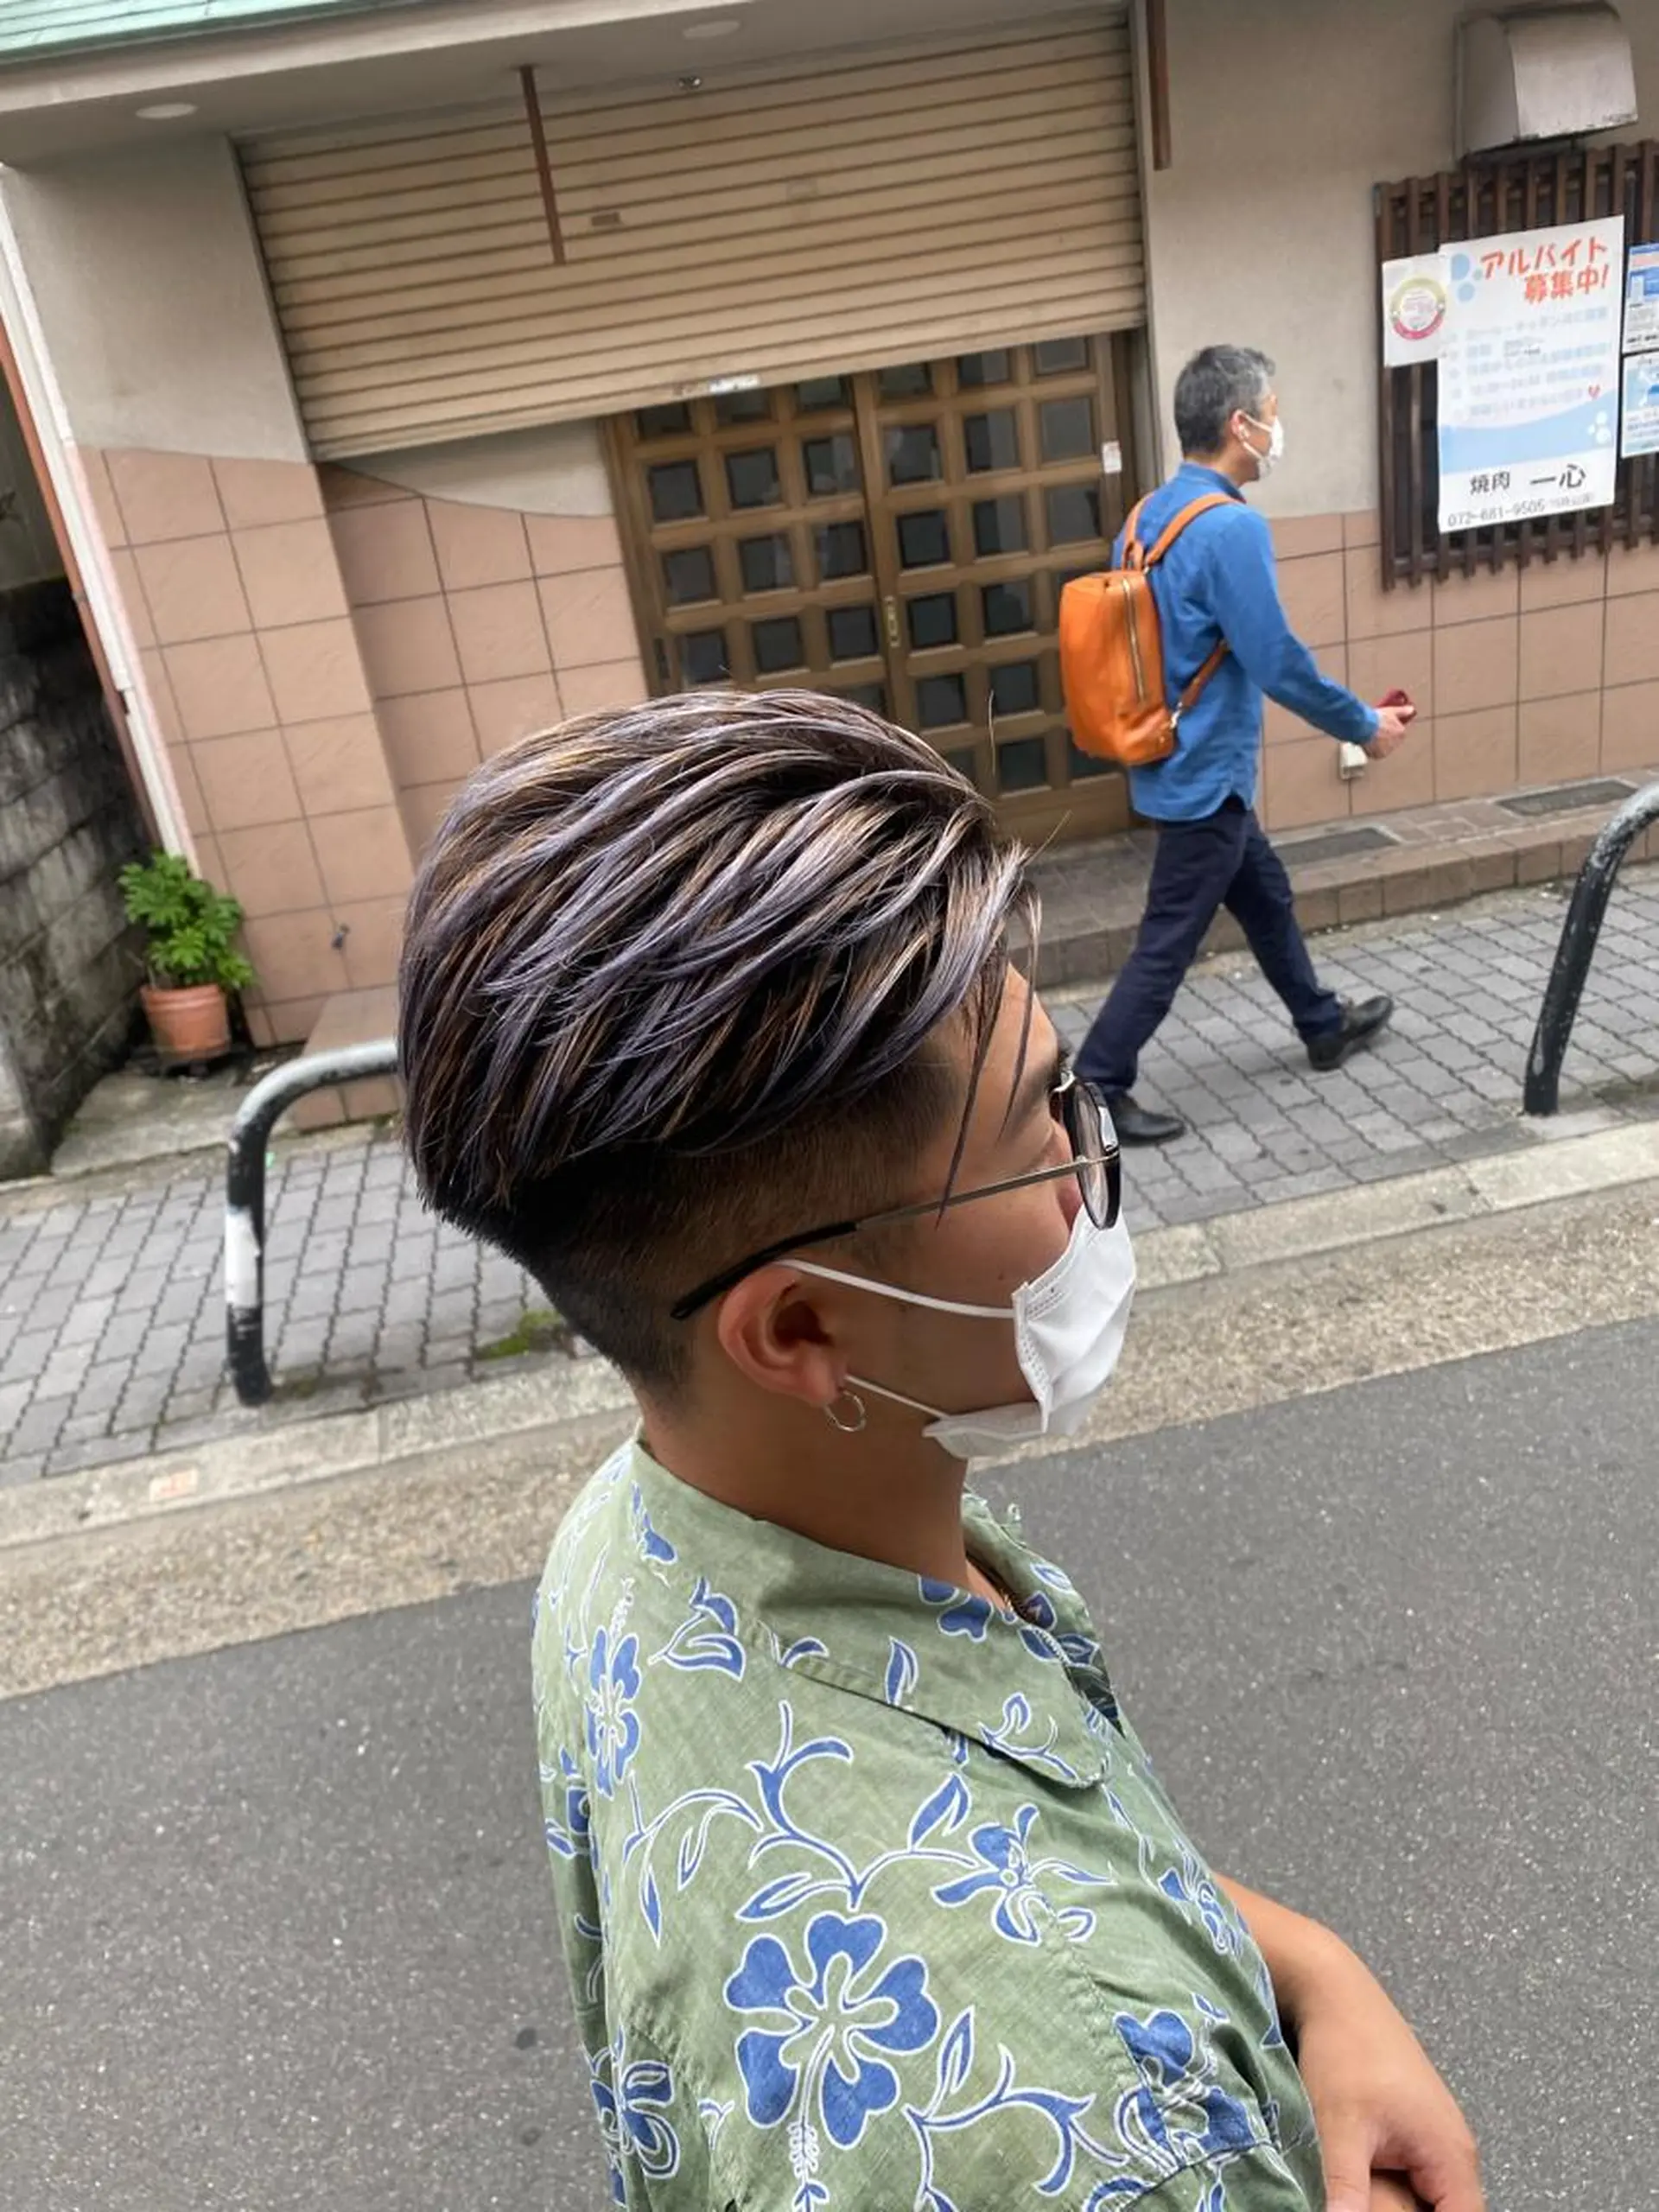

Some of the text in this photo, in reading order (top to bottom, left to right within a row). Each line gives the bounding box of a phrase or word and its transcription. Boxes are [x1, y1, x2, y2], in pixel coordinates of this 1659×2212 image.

[1480, 236, 1608, 278] アルバイト
[1470, 463, 1586, 494] 焼肉 一心
